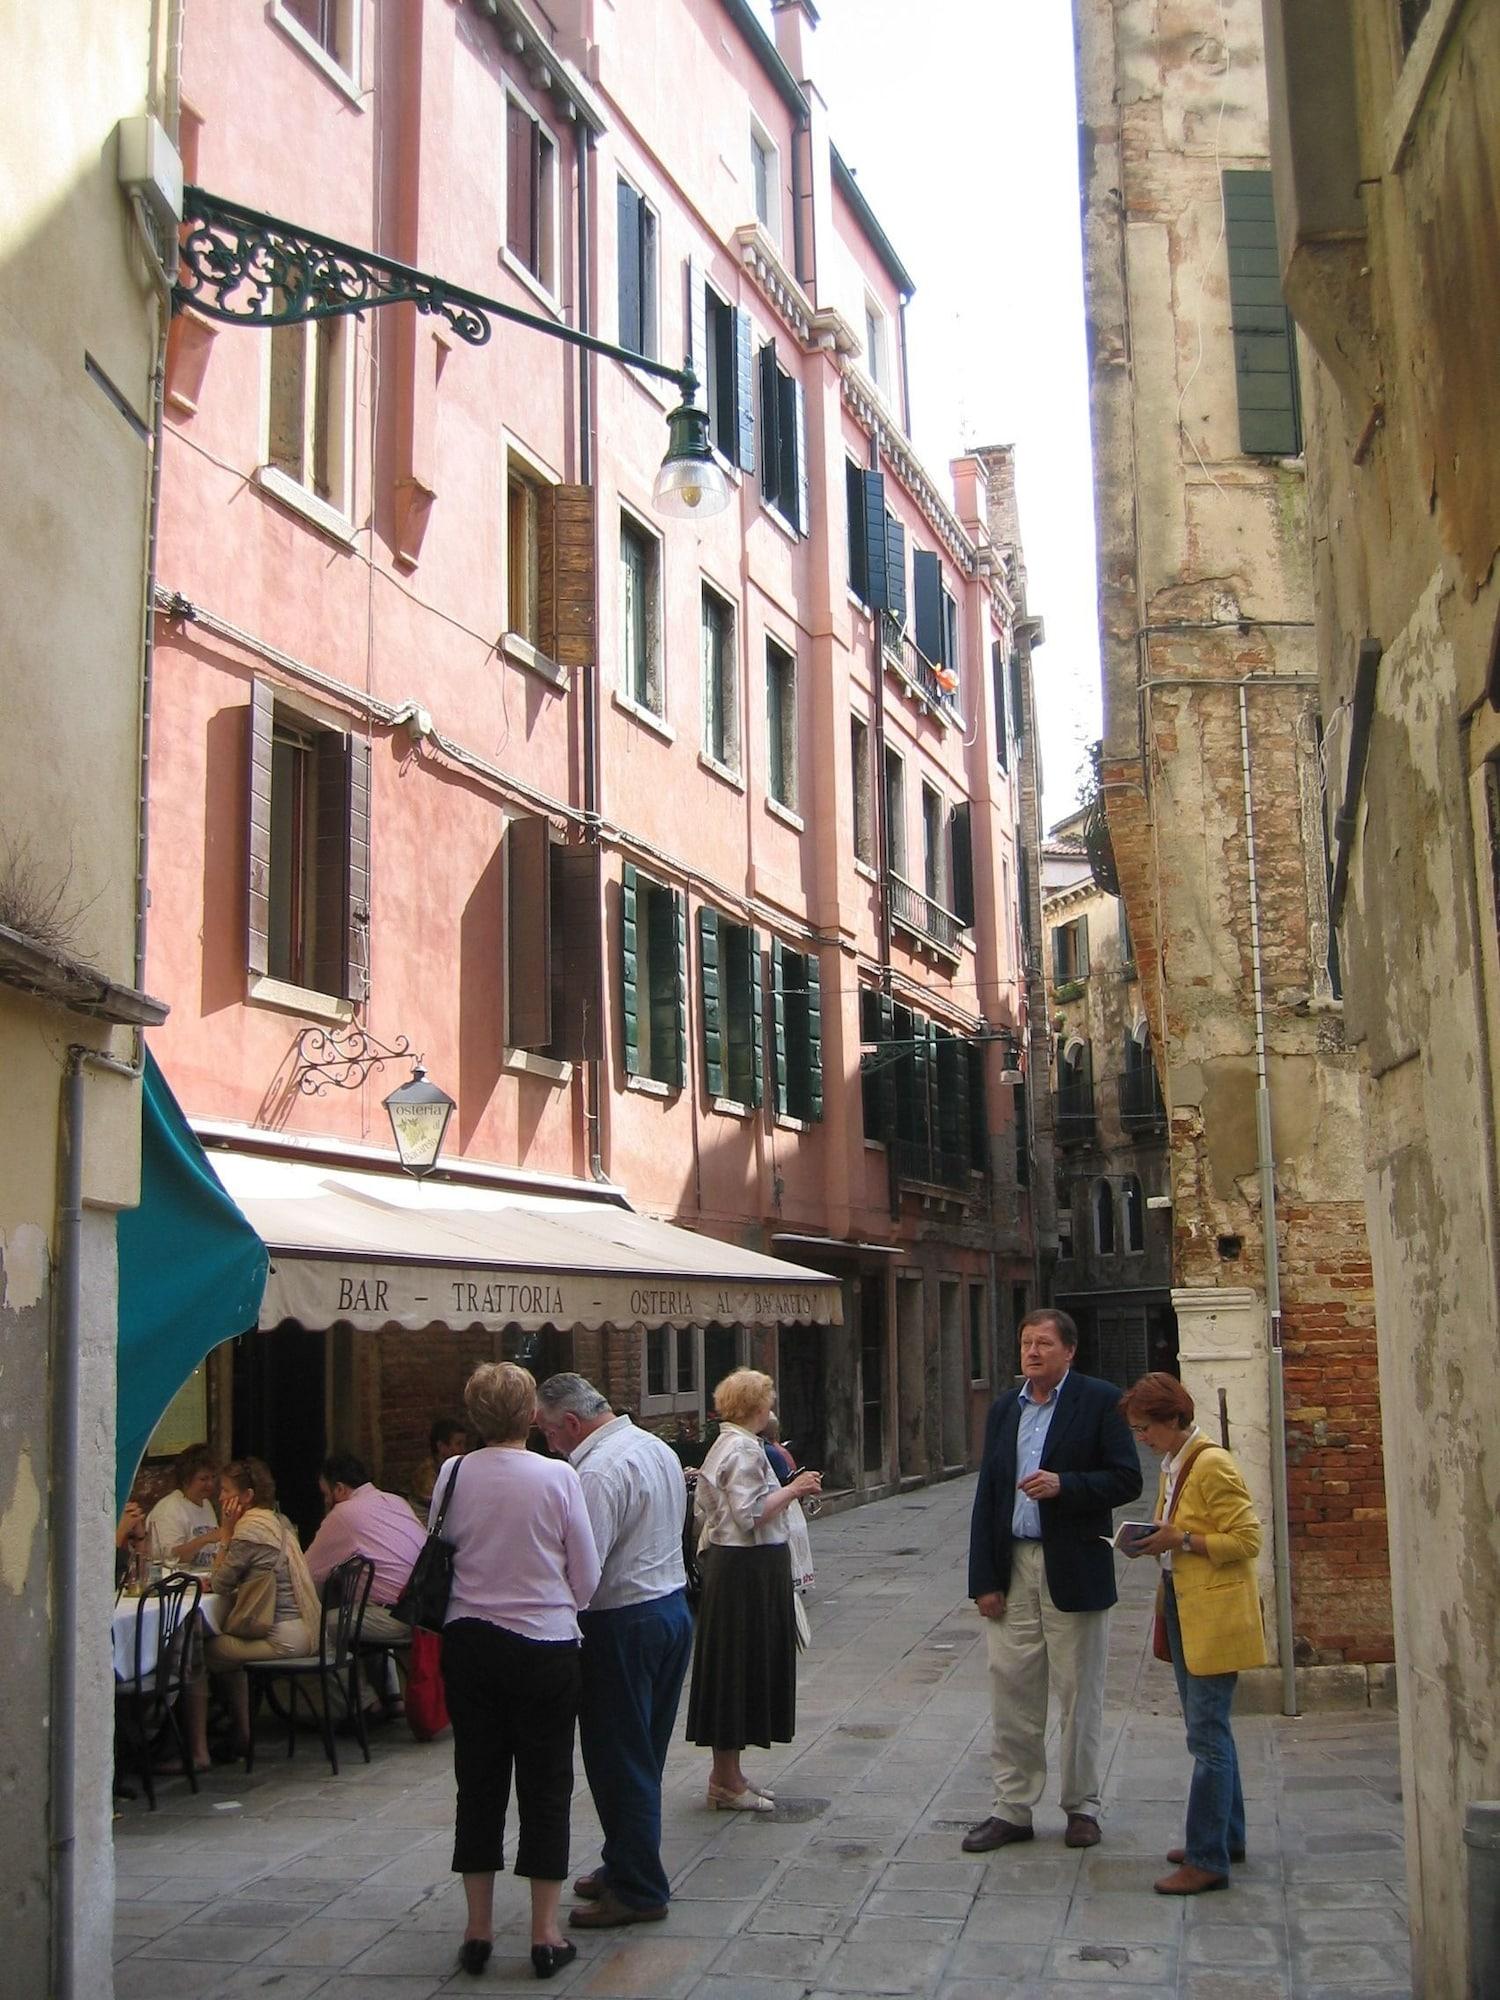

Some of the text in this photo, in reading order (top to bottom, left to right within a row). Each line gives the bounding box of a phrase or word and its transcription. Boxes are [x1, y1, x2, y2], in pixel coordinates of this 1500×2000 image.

[396, 1104, 442, 1116] osteria
[337, 1278, 390, 1312] BAR
[451, 1282, 564, 1314] TRATTORIA
[630, 1289, 694, 1315] OSTERIA
[716, 1291, 733, 1314] AL
